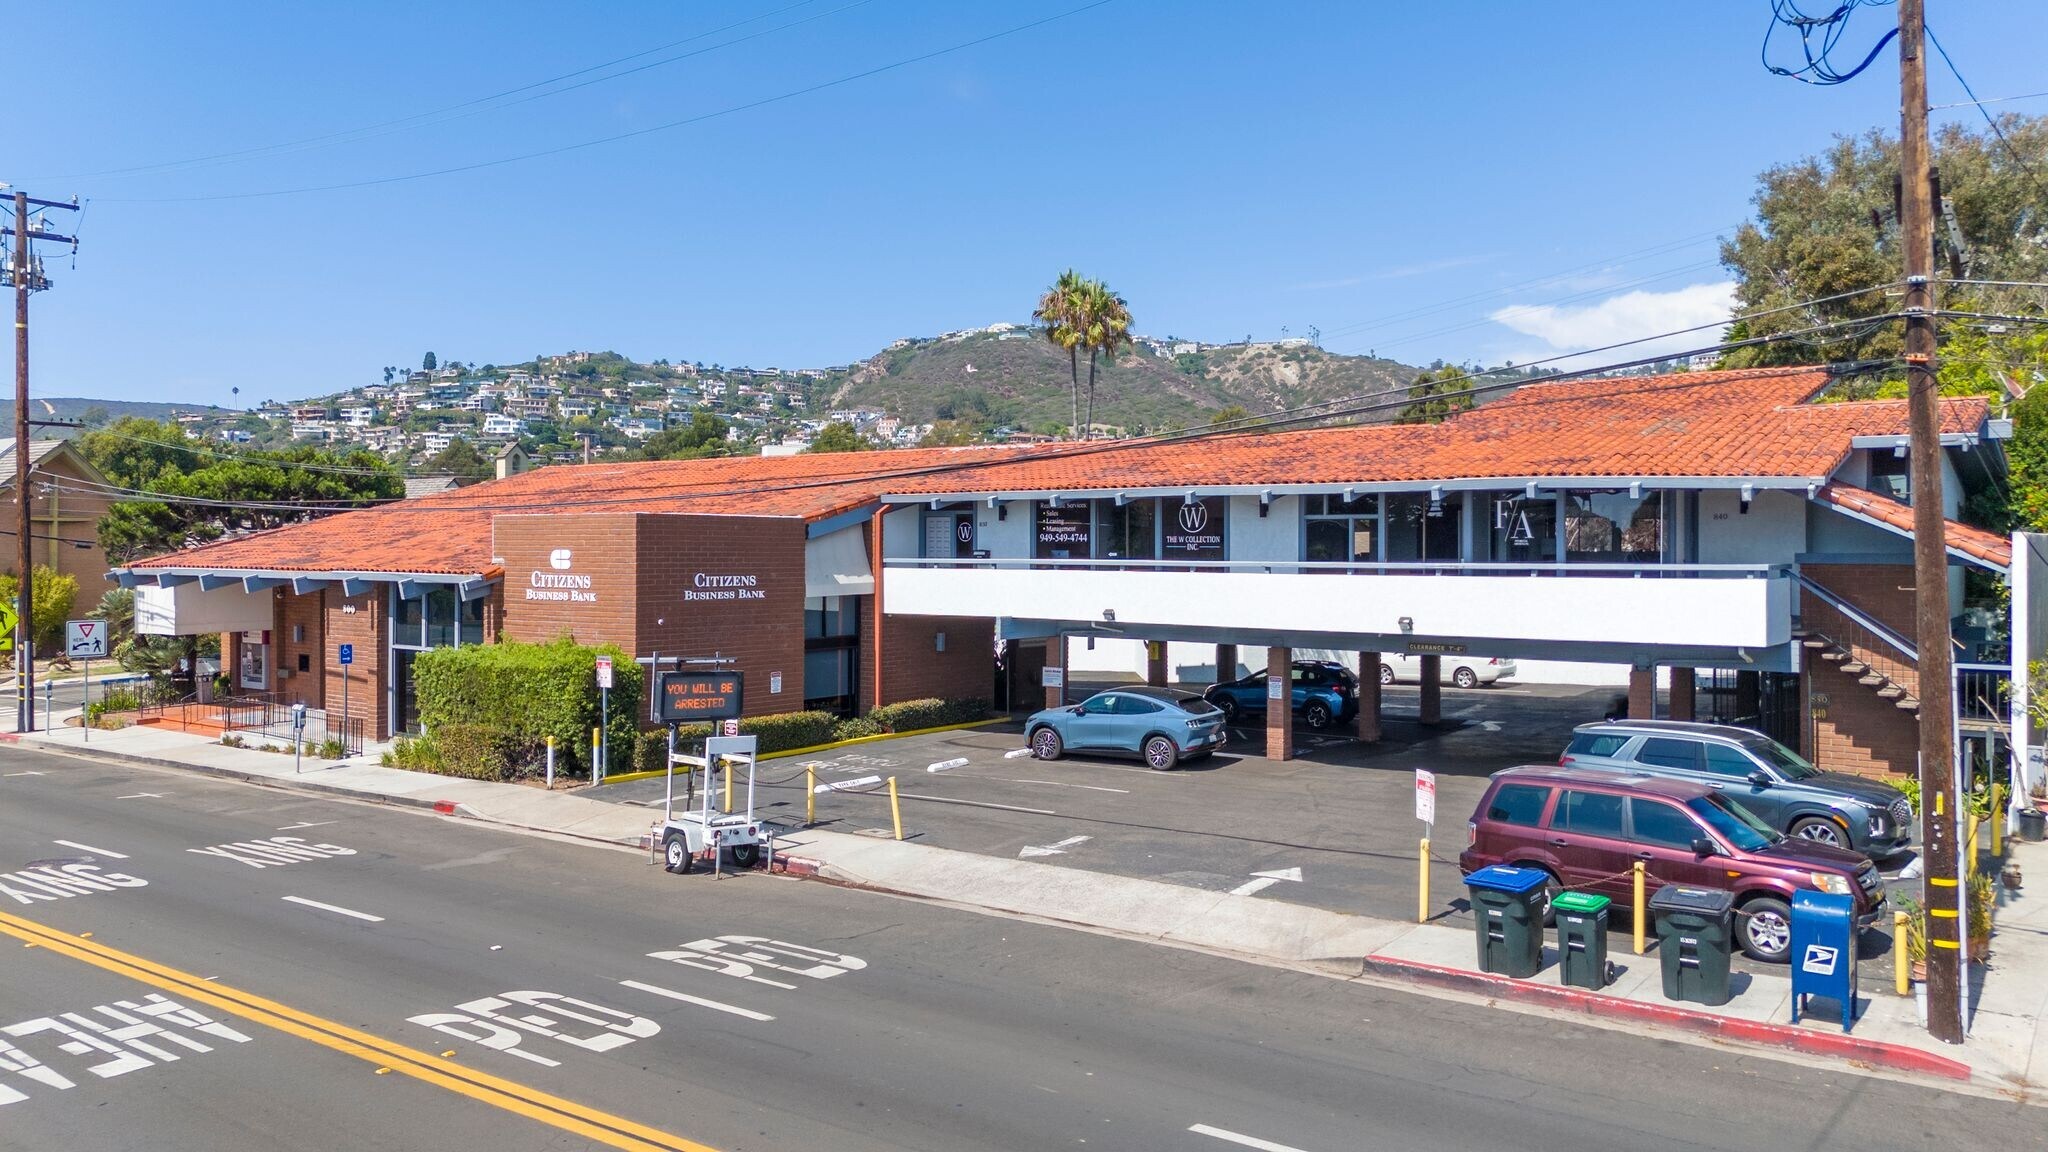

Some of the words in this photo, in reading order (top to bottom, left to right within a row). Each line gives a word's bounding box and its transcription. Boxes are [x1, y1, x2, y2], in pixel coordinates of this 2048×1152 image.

[1181, 507, 1205, 528] W
[1040, 533, 1087, 542] 949-549-4744
[1409, 643, 1445, 651] CLEARANCE
[667, 684, 687, 694] YOU
[692, 683, 715, 694] WILL
[720, 682, 734, 693] BE
[674, 697, 725, 710] ARRESTED
[186, 836, 357, 869] XING
[645, 935, 868, 990] PED
[404, 991, 662, 1067] PED
